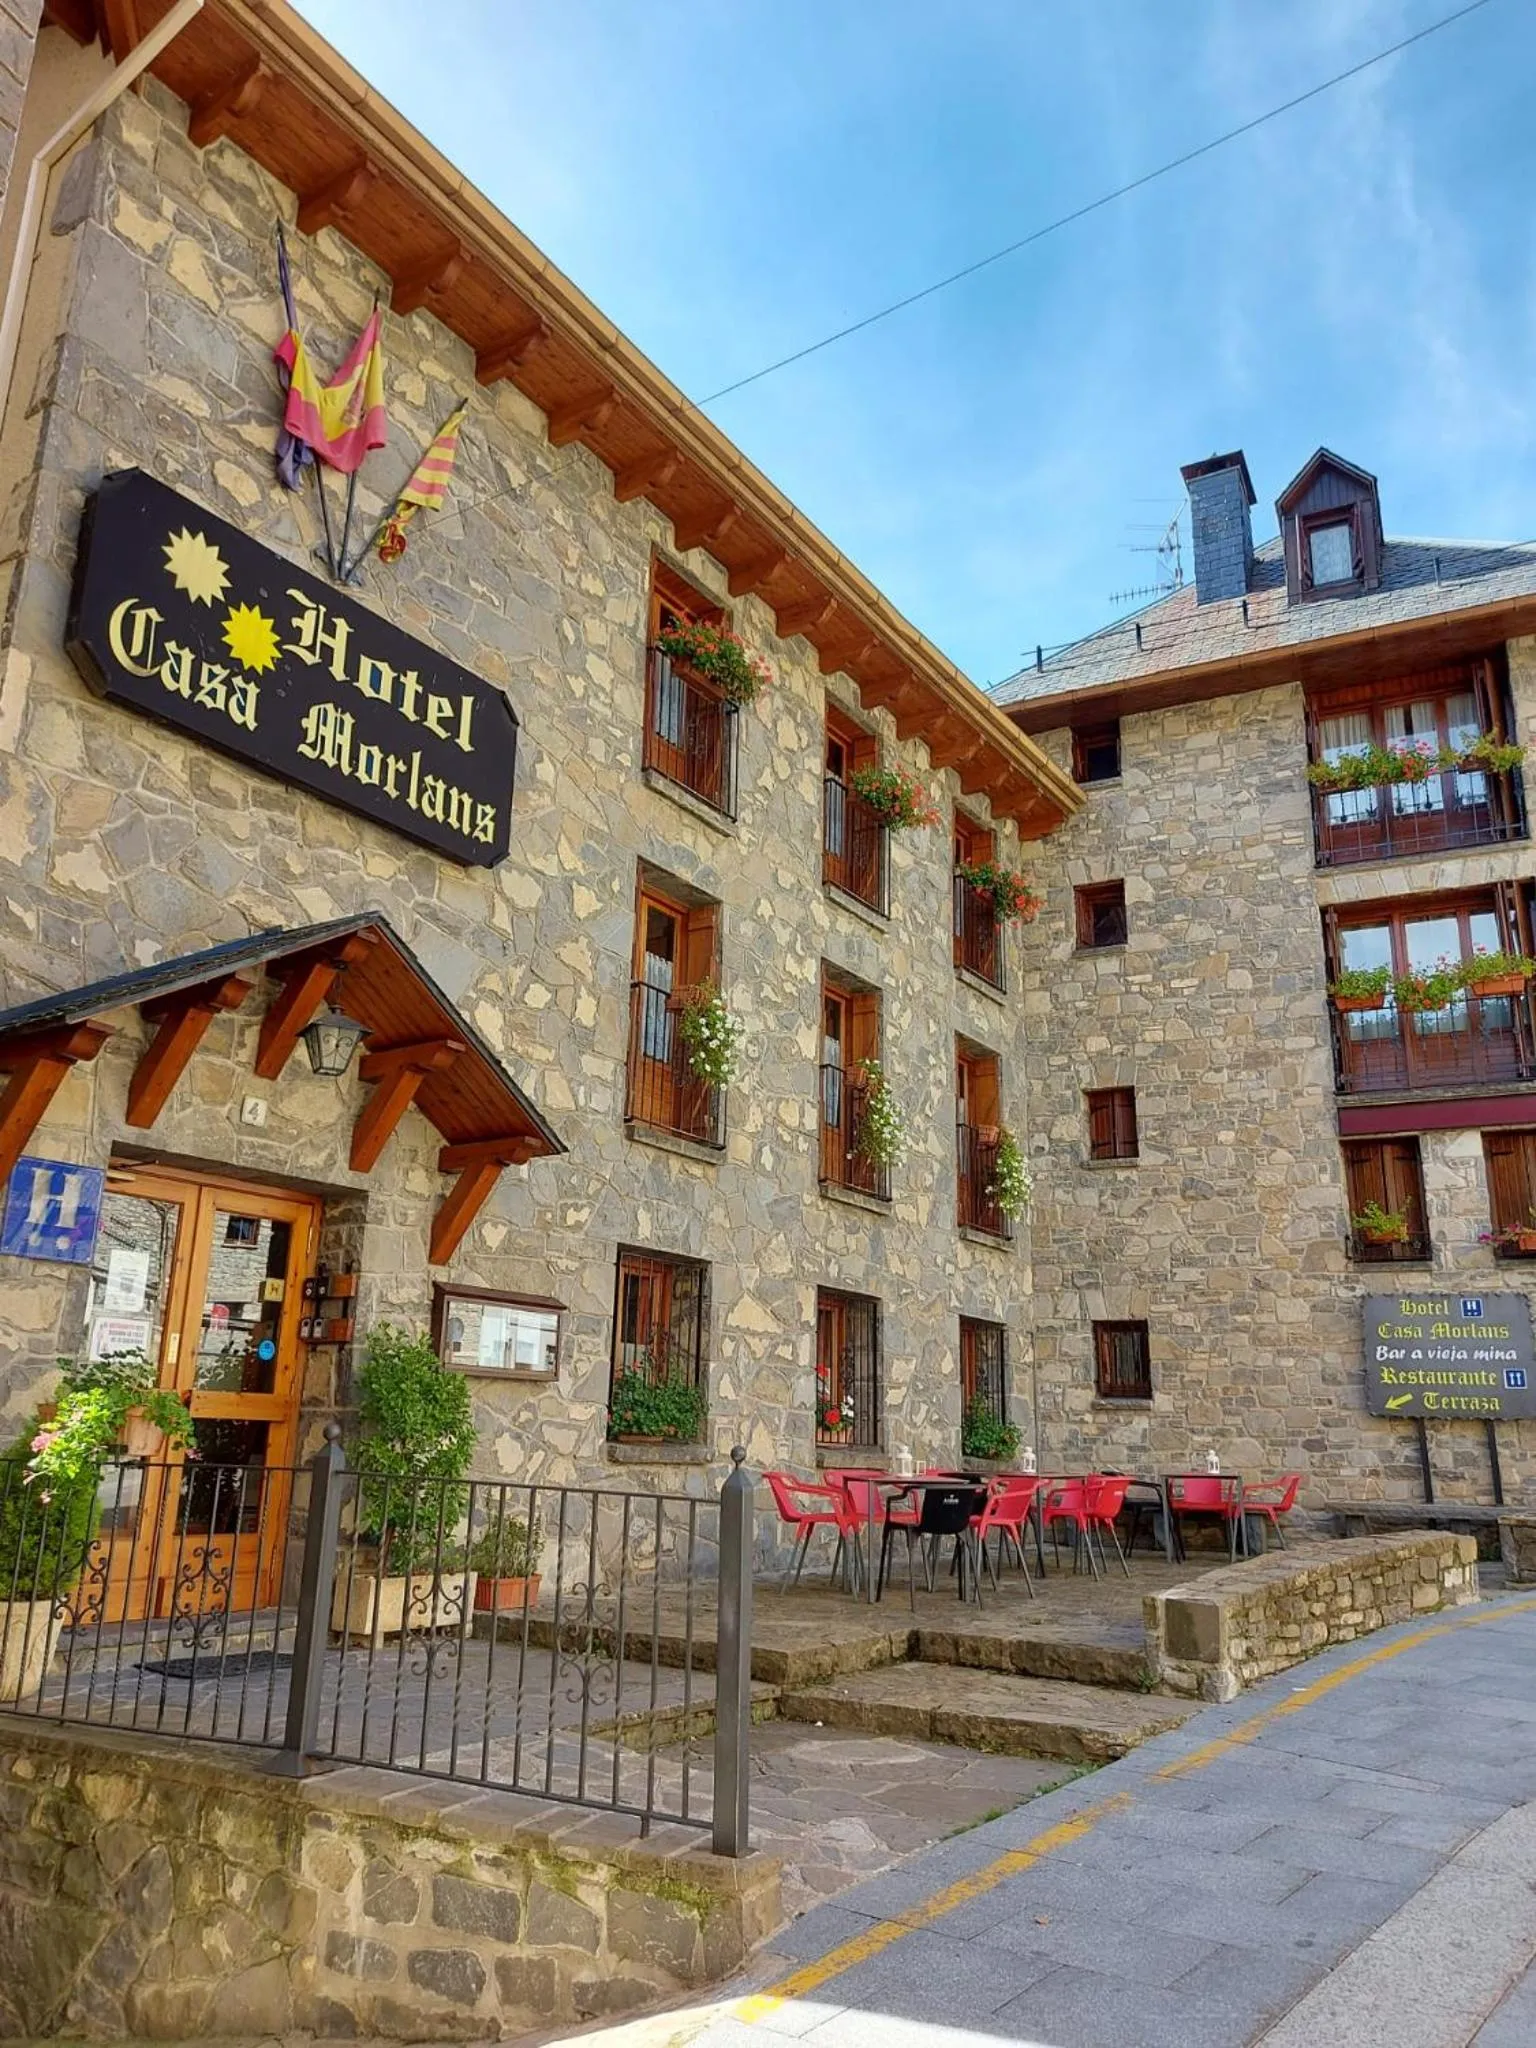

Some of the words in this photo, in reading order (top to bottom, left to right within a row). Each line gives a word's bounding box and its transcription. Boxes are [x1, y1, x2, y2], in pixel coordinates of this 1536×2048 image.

[283, 588, 475, 752] Hotel
[108, 598, 261, 731] Casa
[297, 702, 497, 844] Morlans
[248, 1102, 260, 1120] 4
[27, 1168, 81, 1228] H
[1401, 1299, 1449, 1316] Hotel
[1378, 1322, 1423, 1339] Casa
[1430, 1322, 1509, 1339] Morlans
[1375, 1345, 1405, 1361] Bar
[1411, 1350, 1423, 1360] a
[1427, 1346, 1468, 1363] vieja
[1473, 1346, 1517, 1361] mina
[1380, 1366, 1497, 1384] Restaurante
[1423, 1391, 1500, 1413] Terraza
